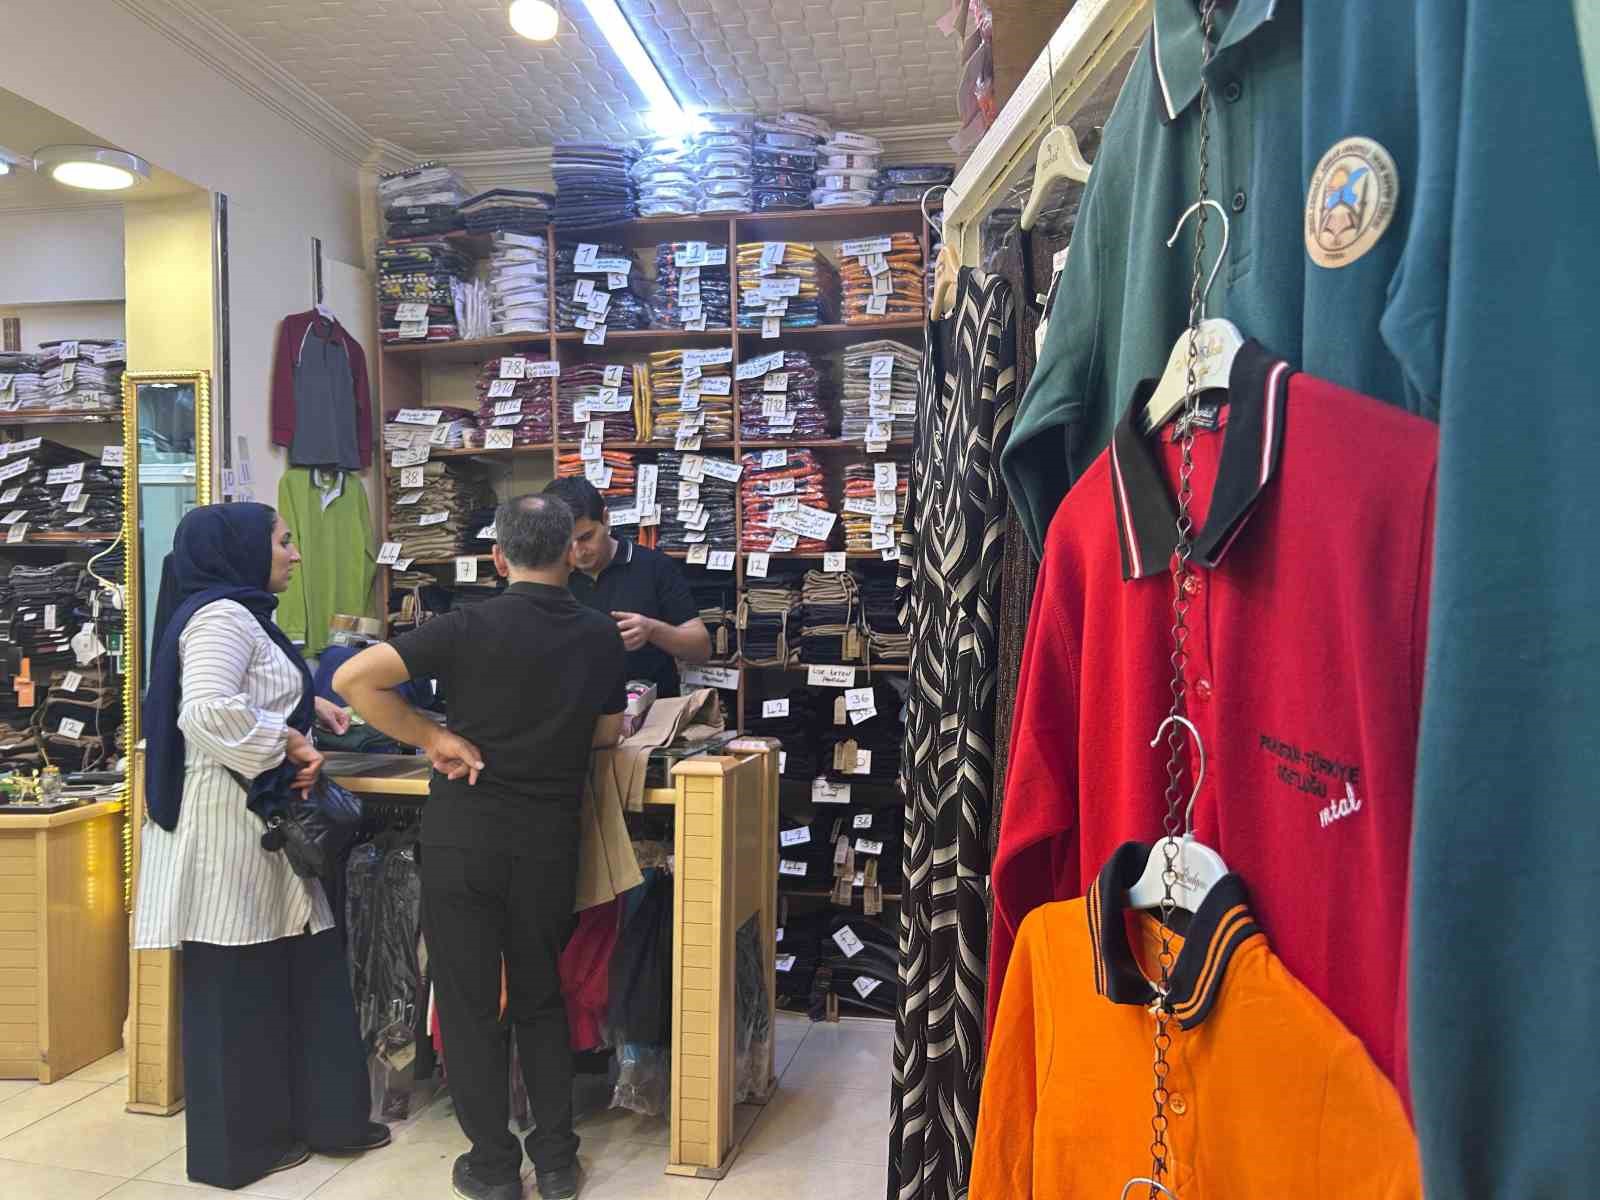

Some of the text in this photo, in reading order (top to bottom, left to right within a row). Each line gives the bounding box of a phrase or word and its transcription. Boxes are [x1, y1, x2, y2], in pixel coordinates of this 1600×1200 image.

[607, 367, 618, 383] 1
[873, 360, 889, 376] 2
[603, 390, 615, 405] 2
[879, 465, 890, 485] 3
